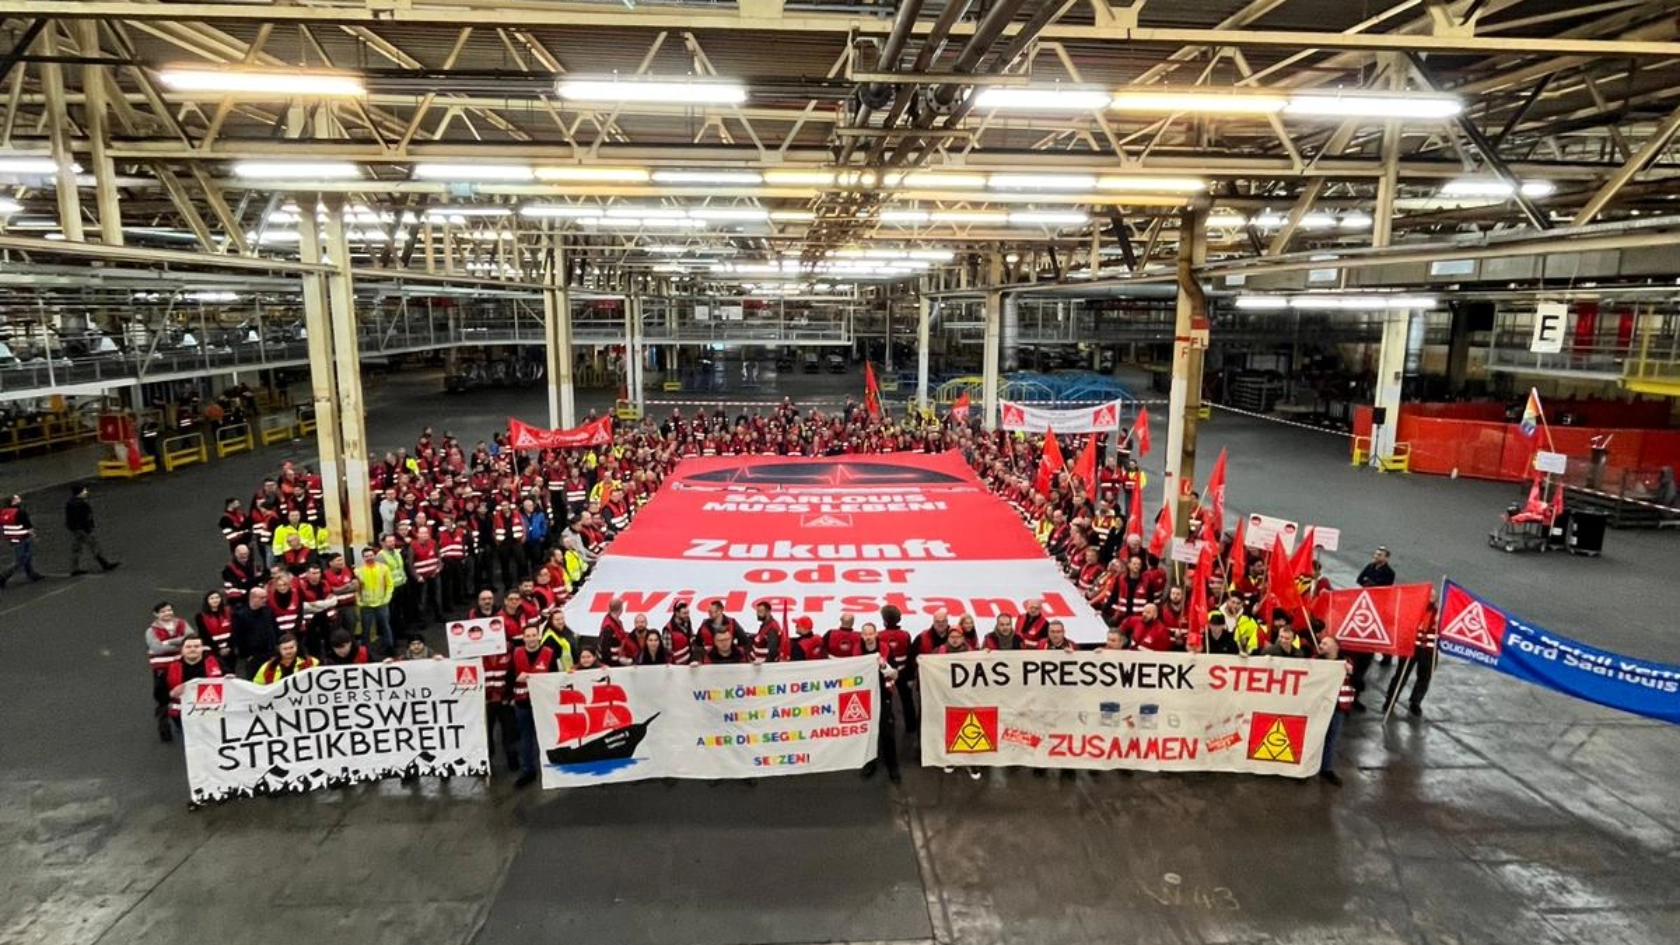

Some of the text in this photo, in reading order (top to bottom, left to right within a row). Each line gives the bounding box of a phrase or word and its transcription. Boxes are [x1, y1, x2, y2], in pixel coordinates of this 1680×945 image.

[1538, 314, 1560, 342] E
[702, 501, 948, 513] MUSS LEBEN!
[724, 493, 927, 503] SAARLOUIS
[683, 538, 958, 559] Zukunft
[743, 564, 915, 583] oder
[589, 590, 1076, 618] Widerstand
[1507, 633, 1559, 661] Ford
[273, 666, 407, 699] JUGEND
[724, 683, 787, 700] KÖNNEN
[790, 681, 821, 694] DEN
[950, 661, 1309, 696] DAS PRESSWERK STEHT
[288, 686, 432, 706] WIDERSTAND
[219, 699, 459, 745] LANDESWEIT
[762, 730, 807, 744] SEGEL
[809, 723, 869, 740] ANDERS
[217, 724, 466, 771] STREIKBEREIT
[1047, 734, 1199, 761] ZUSAMMEN
